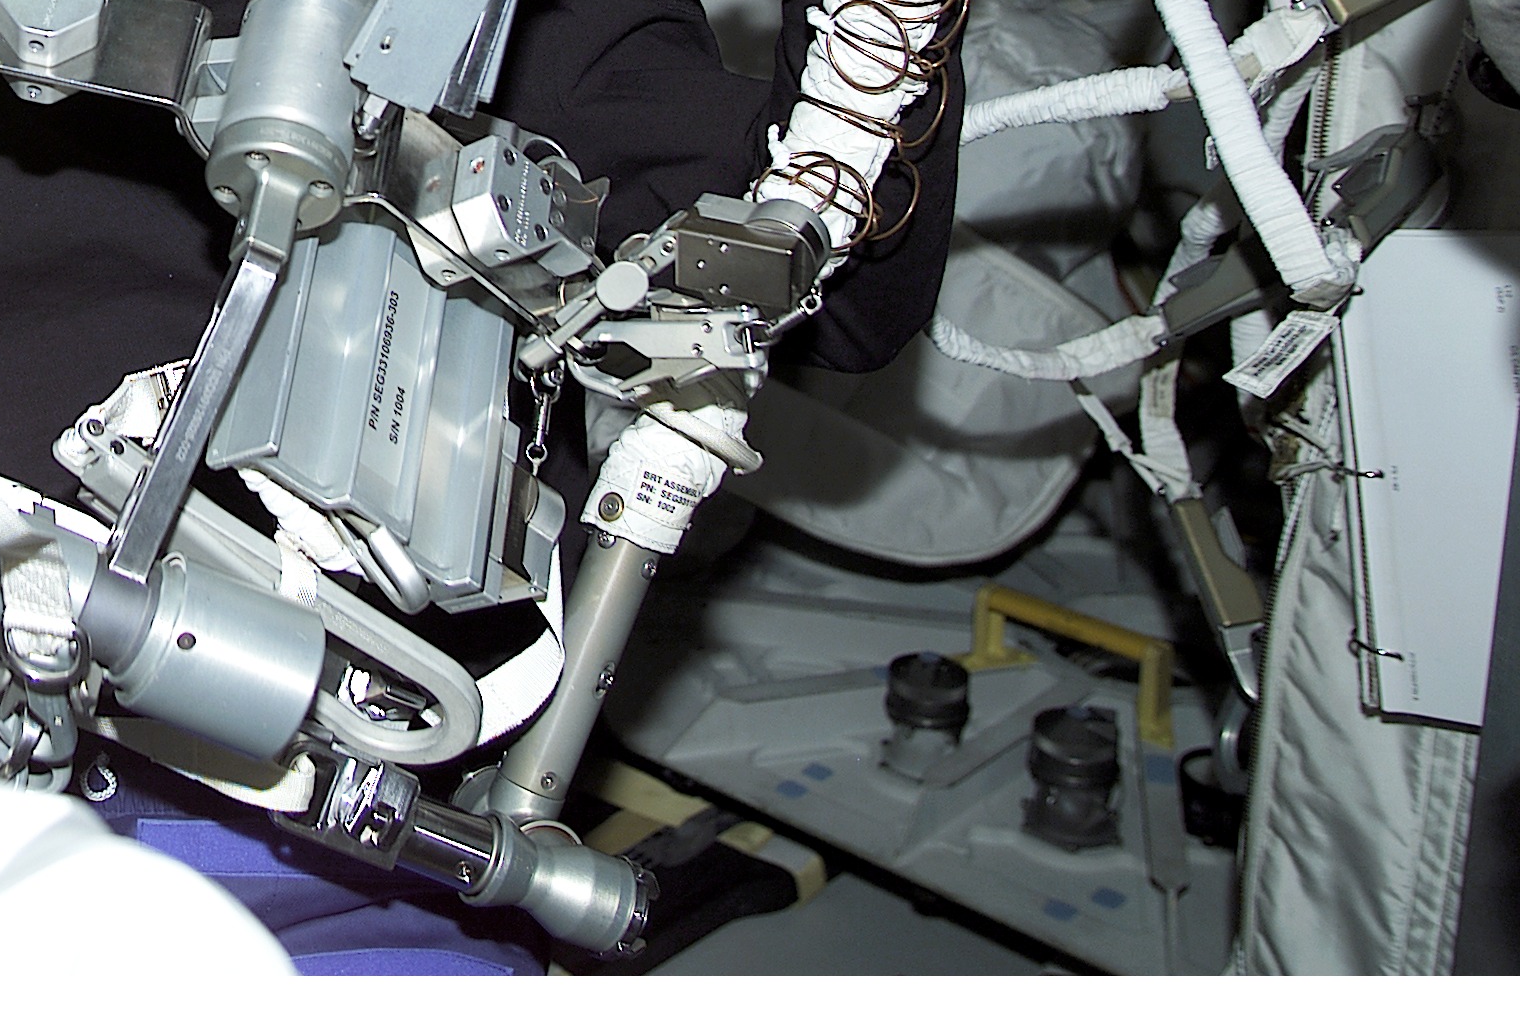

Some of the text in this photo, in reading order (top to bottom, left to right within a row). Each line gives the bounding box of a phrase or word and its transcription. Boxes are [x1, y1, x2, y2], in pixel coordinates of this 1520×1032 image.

[368, 404, 381, 431] P/N
[389, 386, 407, 445] S/N 1004
